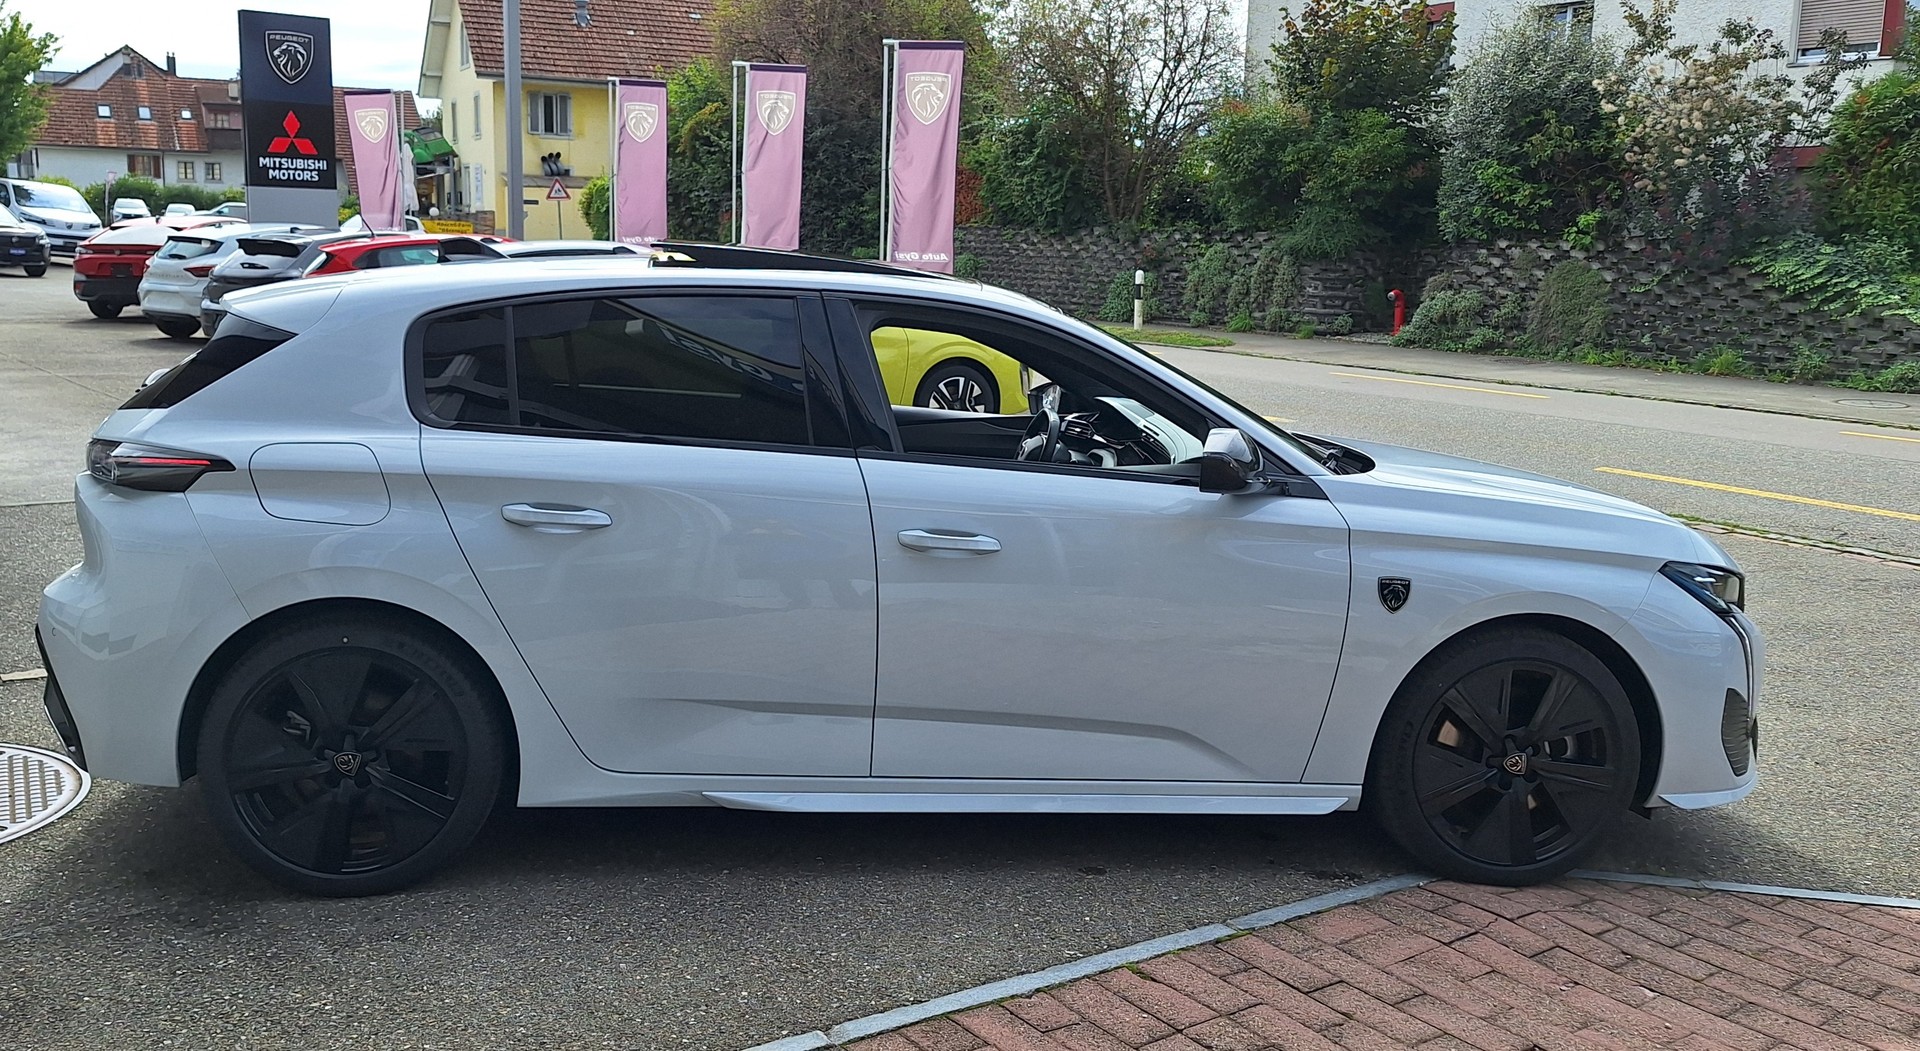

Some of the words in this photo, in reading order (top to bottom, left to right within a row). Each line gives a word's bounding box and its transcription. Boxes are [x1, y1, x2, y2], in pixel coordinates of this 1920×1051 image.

[269, 34, 310, 43] PEUGEOT
[259, 156, 327, 170] MITSUBISHI
[268, 169, 319, 181] MOTORS
